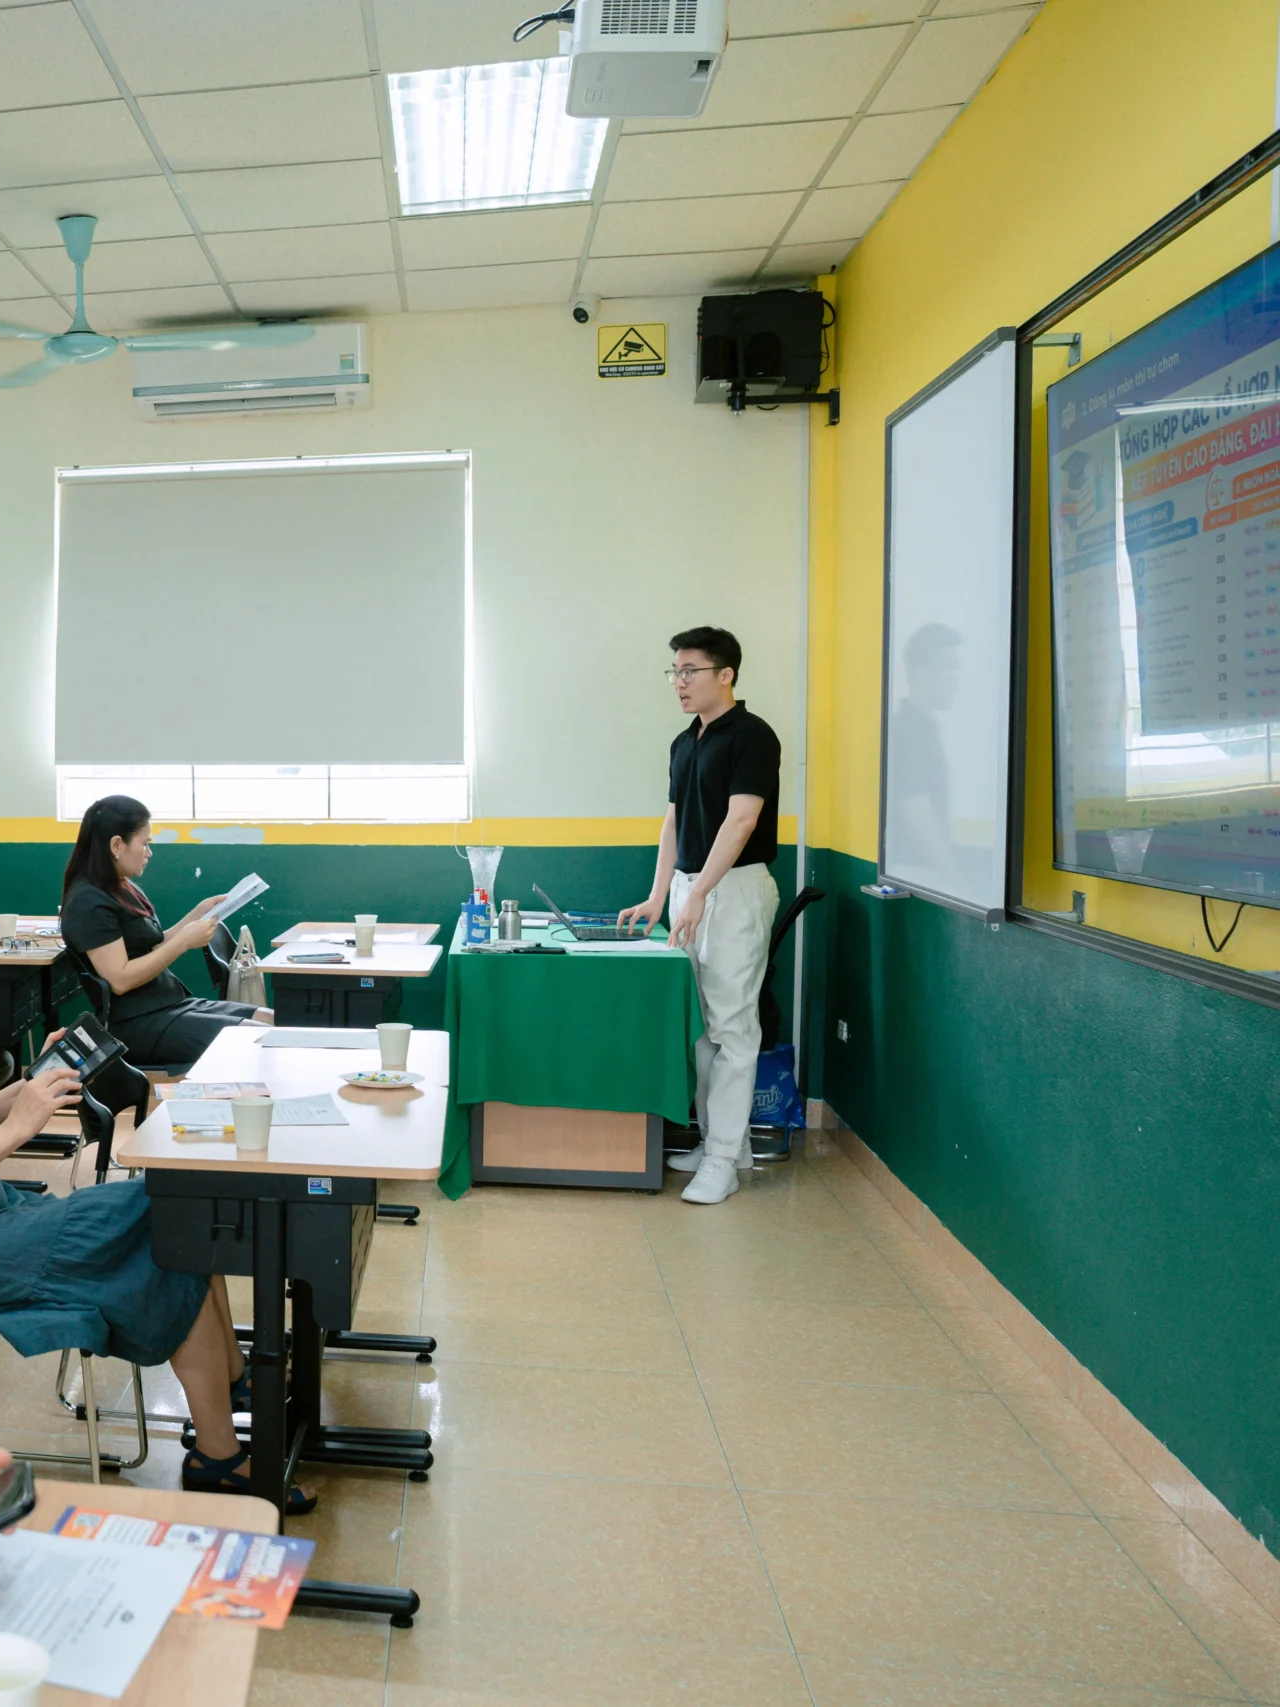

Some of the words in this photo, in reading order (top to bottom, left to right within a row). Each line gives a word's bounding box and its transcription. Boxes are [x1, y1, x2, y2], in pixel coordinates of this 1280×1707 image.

[1157, 353, 1179, 373] chọn
[1152, 414, 1179, 449] HỢP
[1184, 444, 1207, 472] CAO
[1250, 417, 1272, 448] ĐẠI
